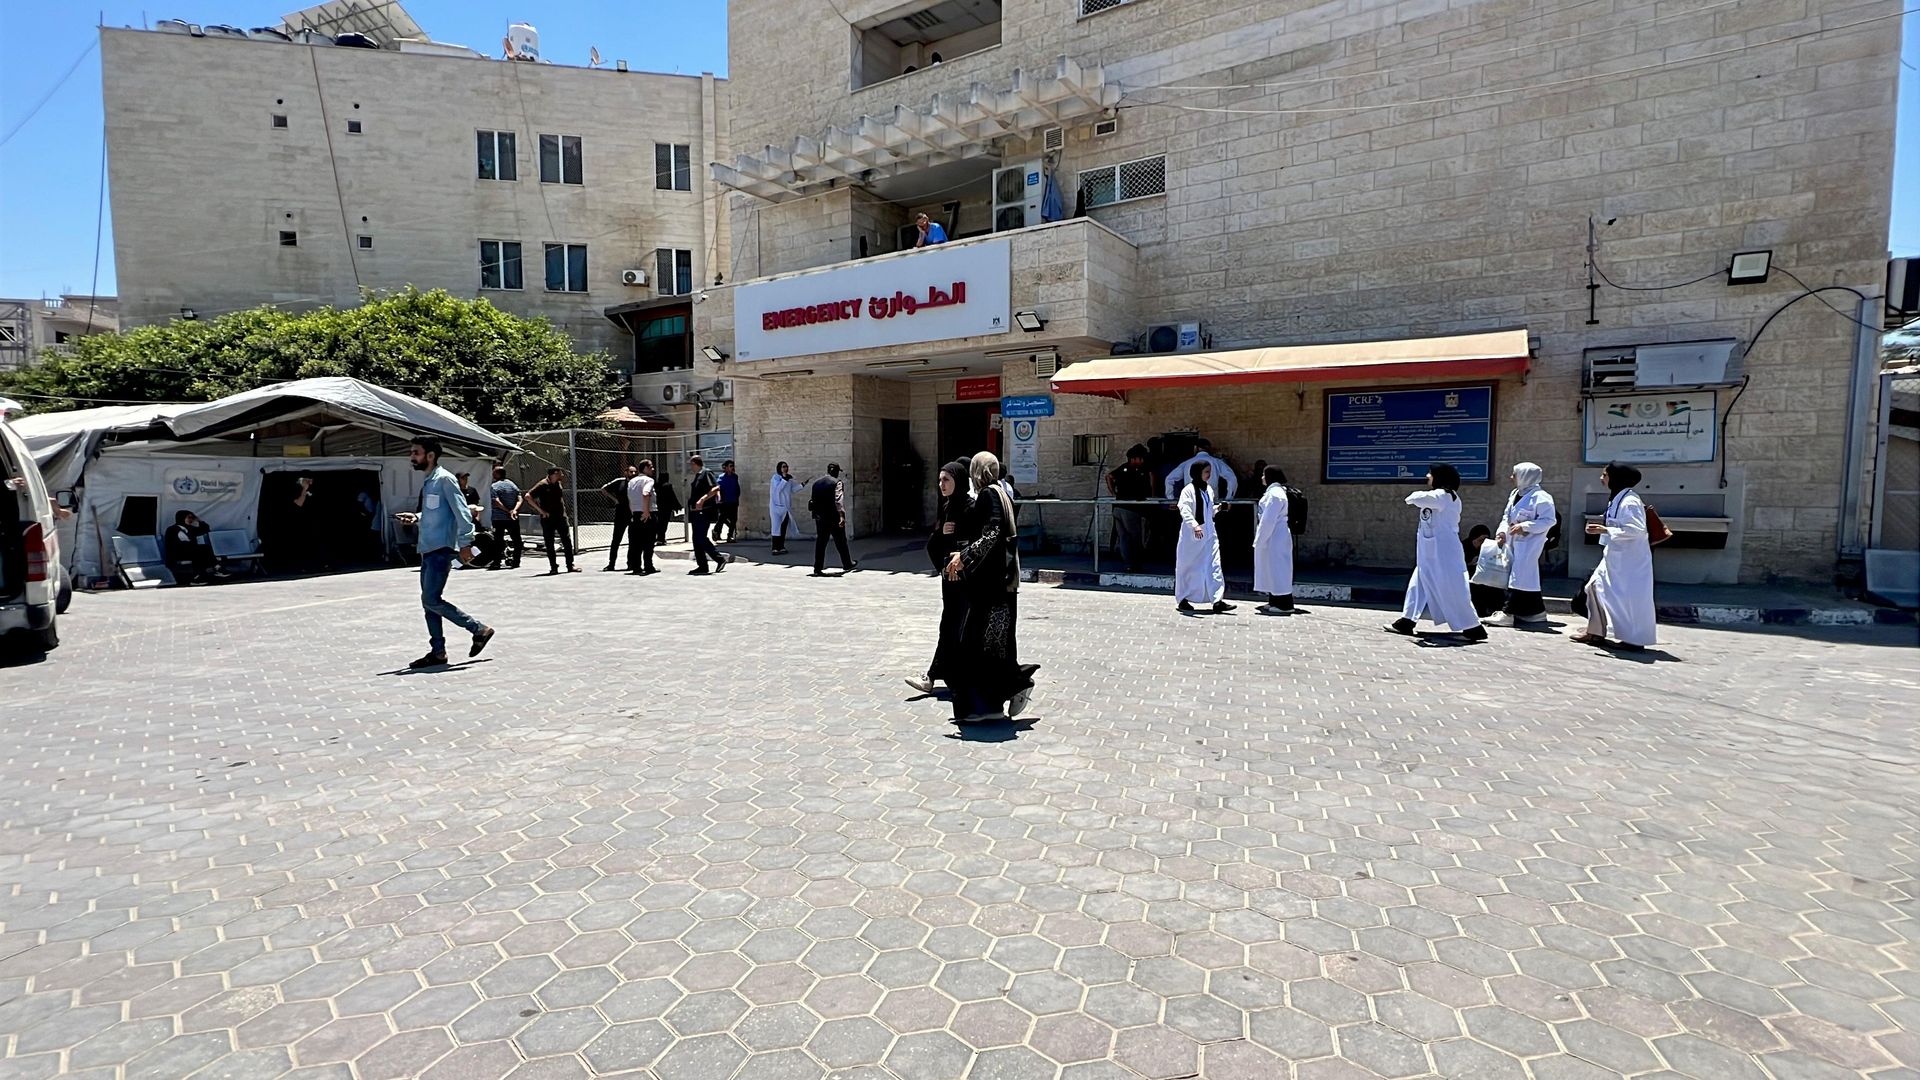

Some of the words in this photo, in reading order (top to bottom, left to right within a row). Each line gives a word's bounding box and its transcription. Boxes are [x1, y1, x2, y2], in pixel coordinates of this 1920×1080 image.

[868, 281, 966, 320] الطوارئ
[762, 298, 862, 331] EMERGENCY
[1348, 395, 1373, 405] PCRF
[1692, 428, 1704, 436] في
